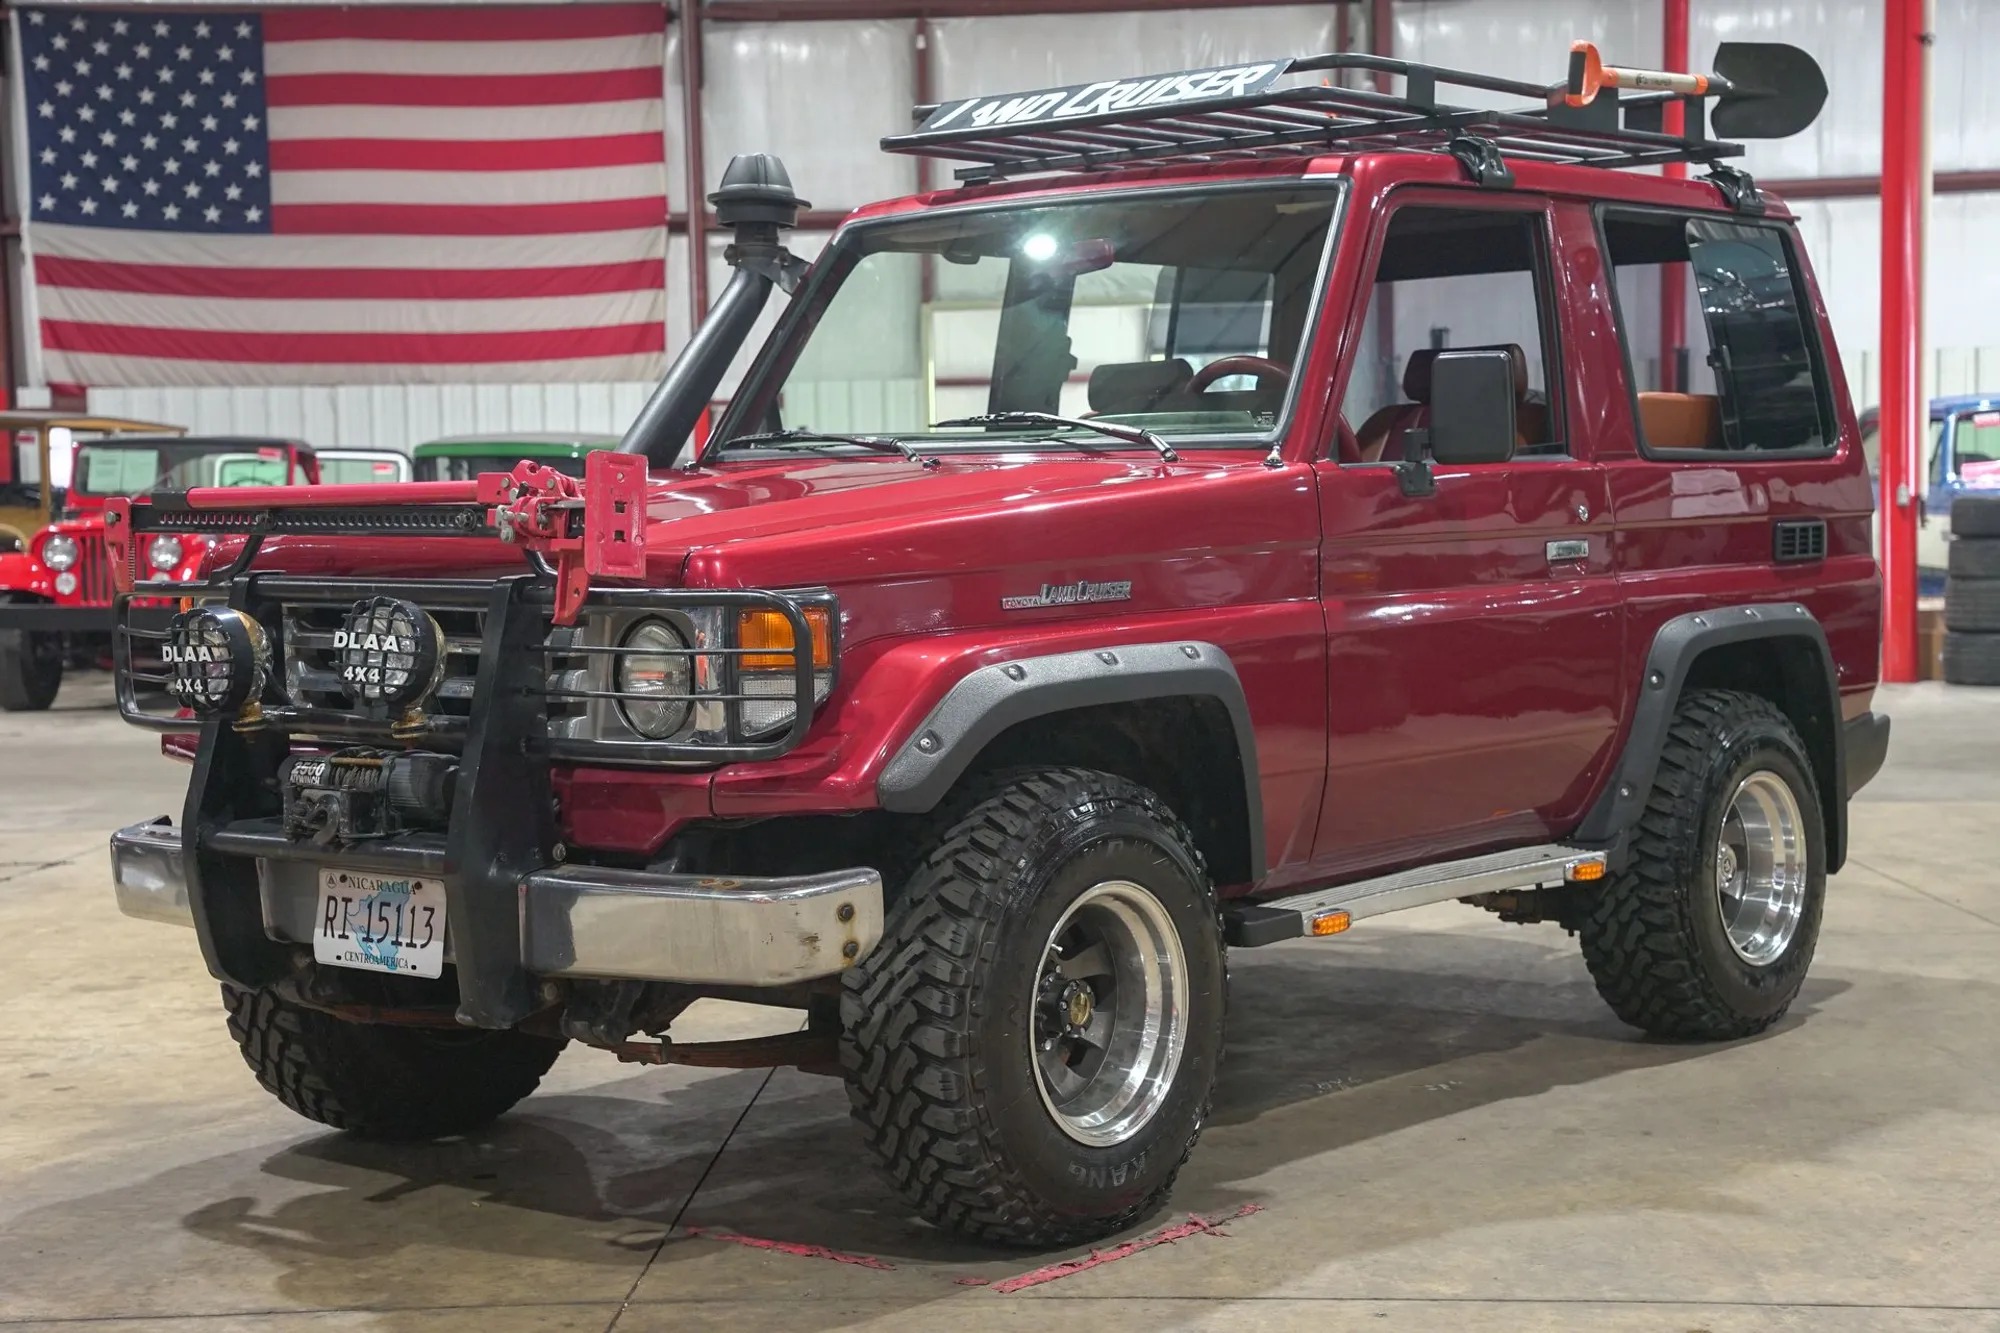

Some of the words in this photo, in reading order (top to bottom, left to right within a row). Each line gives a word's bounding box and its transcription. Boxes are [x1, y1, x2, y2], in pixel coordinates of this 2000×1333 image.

[1053, 63, 1277, 117] CRUISER
[1003, 598, 1039, 609] TOYOTA
[1040, 583, 1078, 603] LAND
[1077, 580, 1132, 601] CRUISER
[334, 631, 400, 652] DLAA
[162, 645, 212, 663] DLAA
[343, 666, 381, 683] 4X4
[174, 678, 203, 694] 4X4
[291, 761, 326, 776] 2500
[348, 878, 417, 896] NICARAGUA
[323, 895, 353, 940] RI
[361, 900, 436, 949] 15113
[344, 950, 409, 969] CENTROAMERICA
